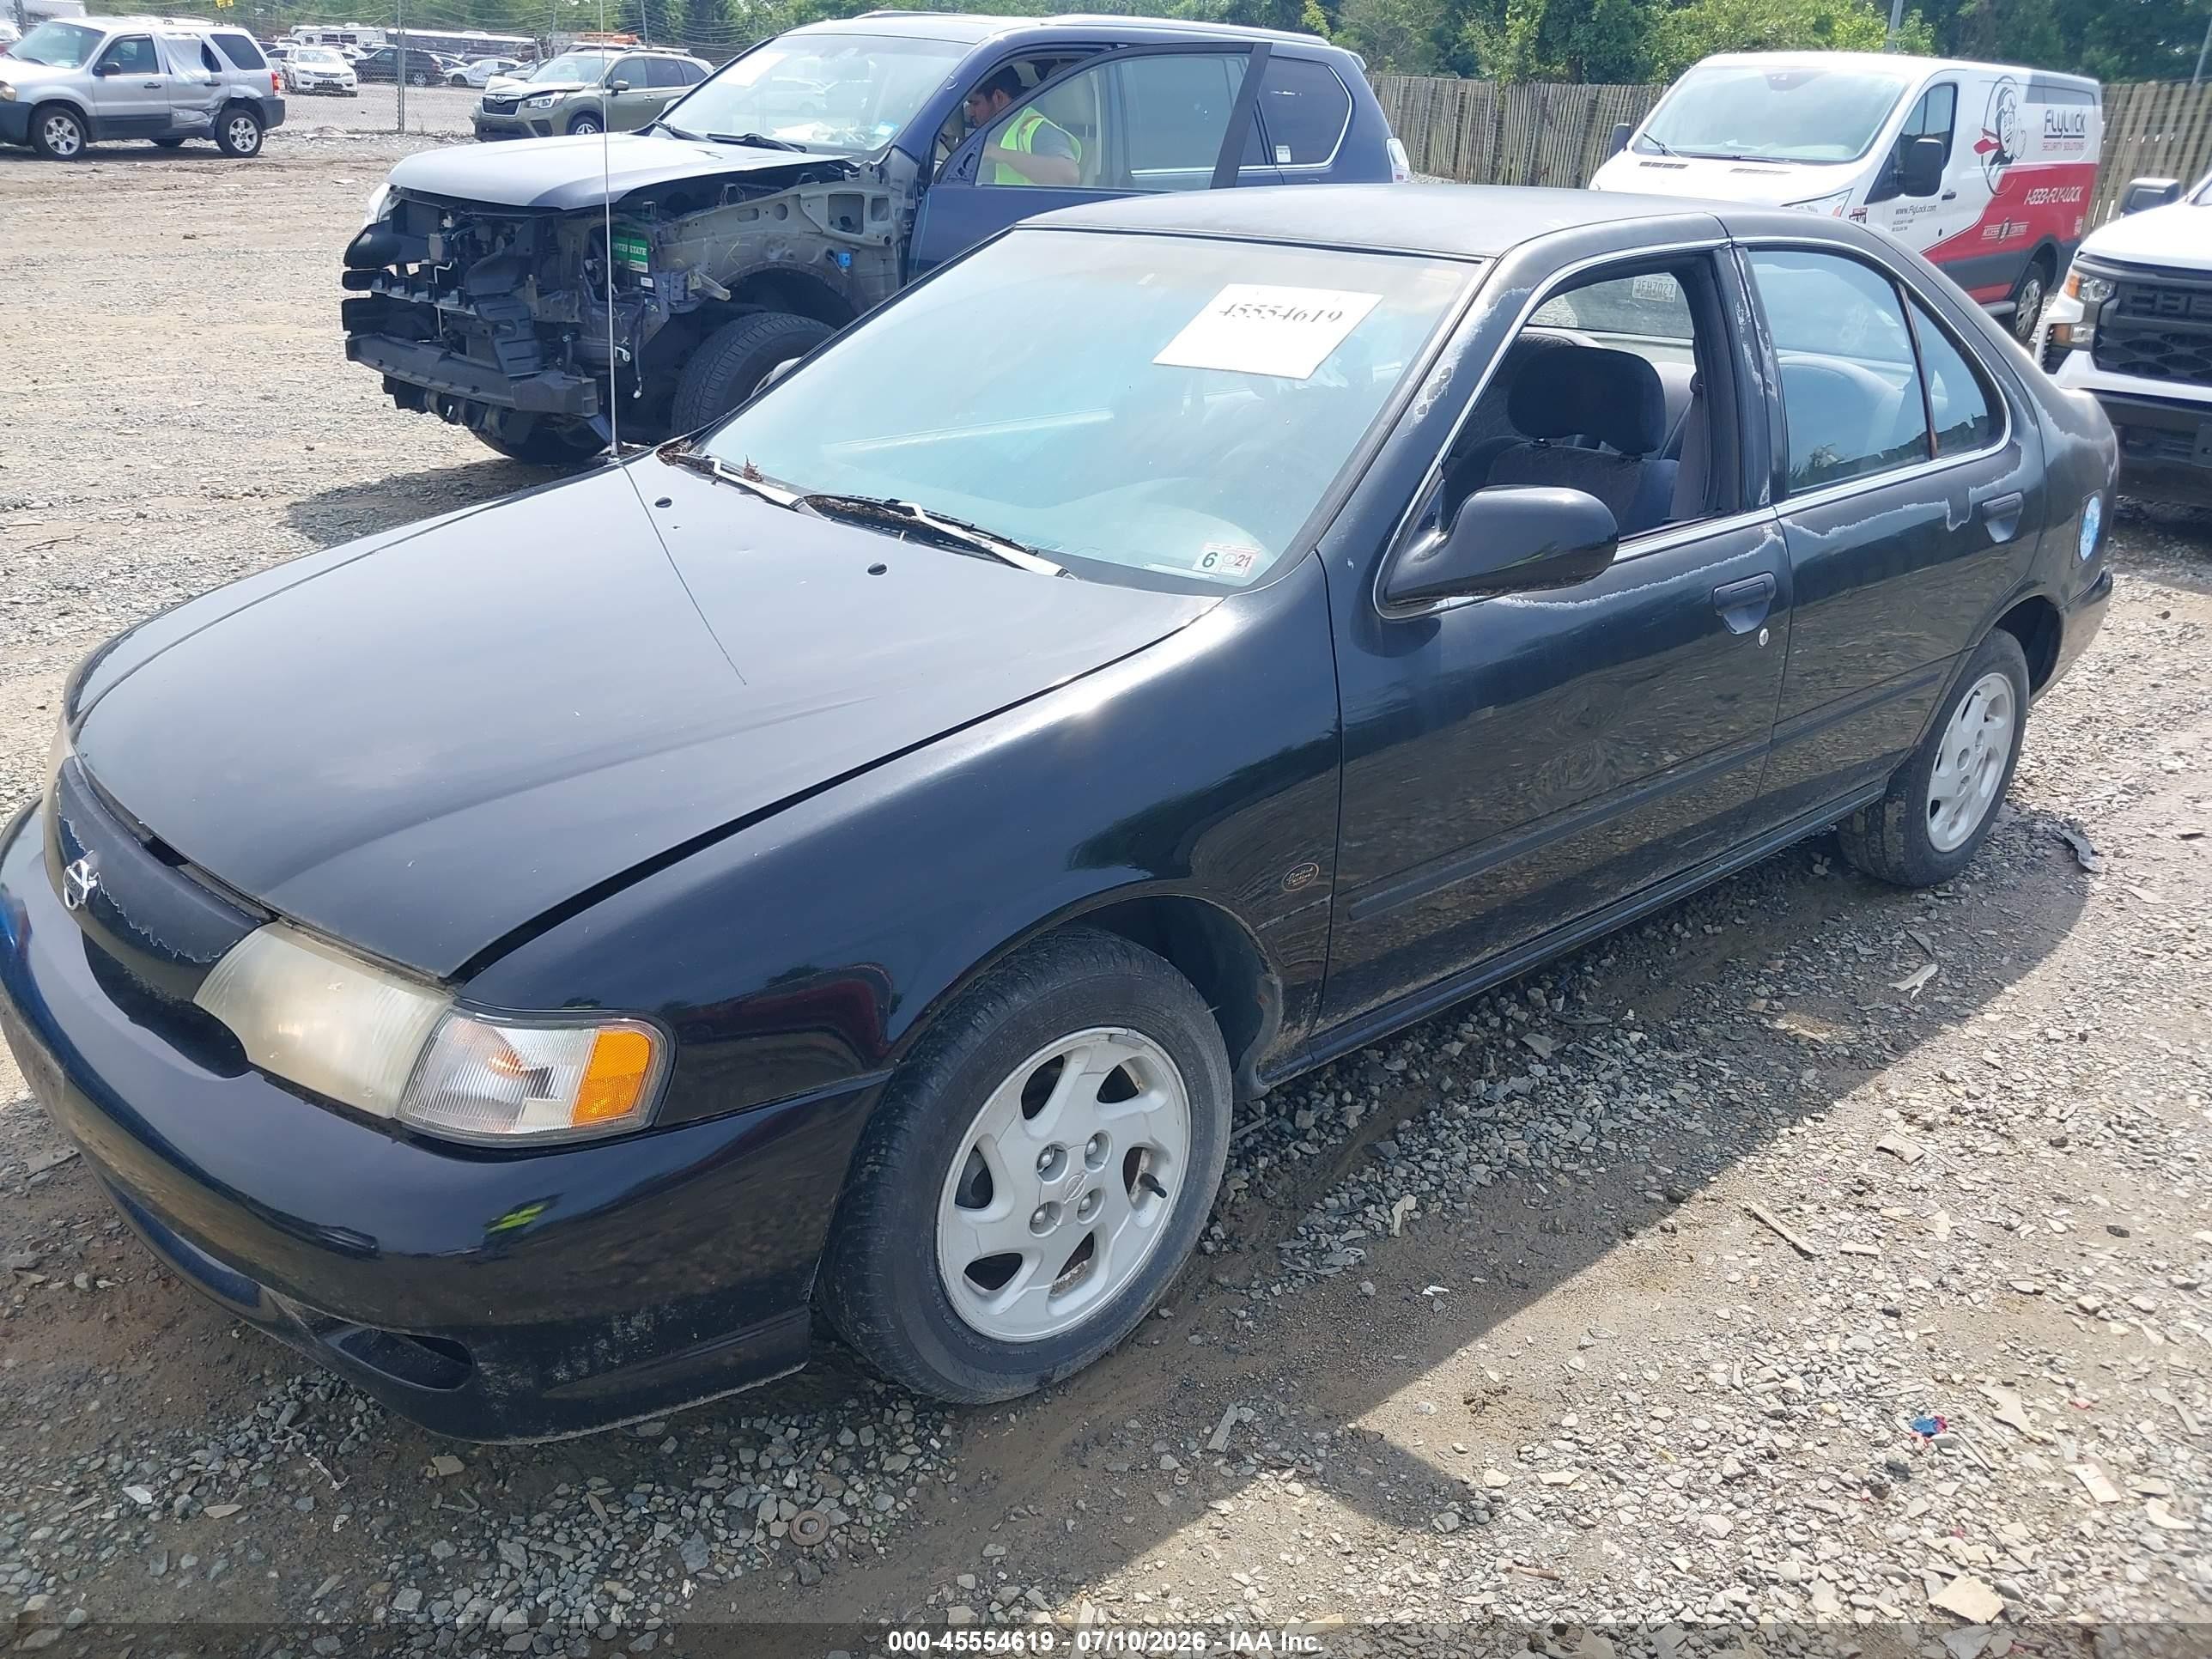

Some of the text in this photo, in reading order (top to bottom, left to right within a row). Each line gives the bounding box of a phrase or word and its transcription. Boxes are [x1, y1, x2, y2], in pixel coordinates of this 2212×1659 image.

[1895, 205, 1937, 216] www.FlyLock.com
[1218, 301, 1344, 323] 45554619
[1202, 552, 1251, 568] 6 21
